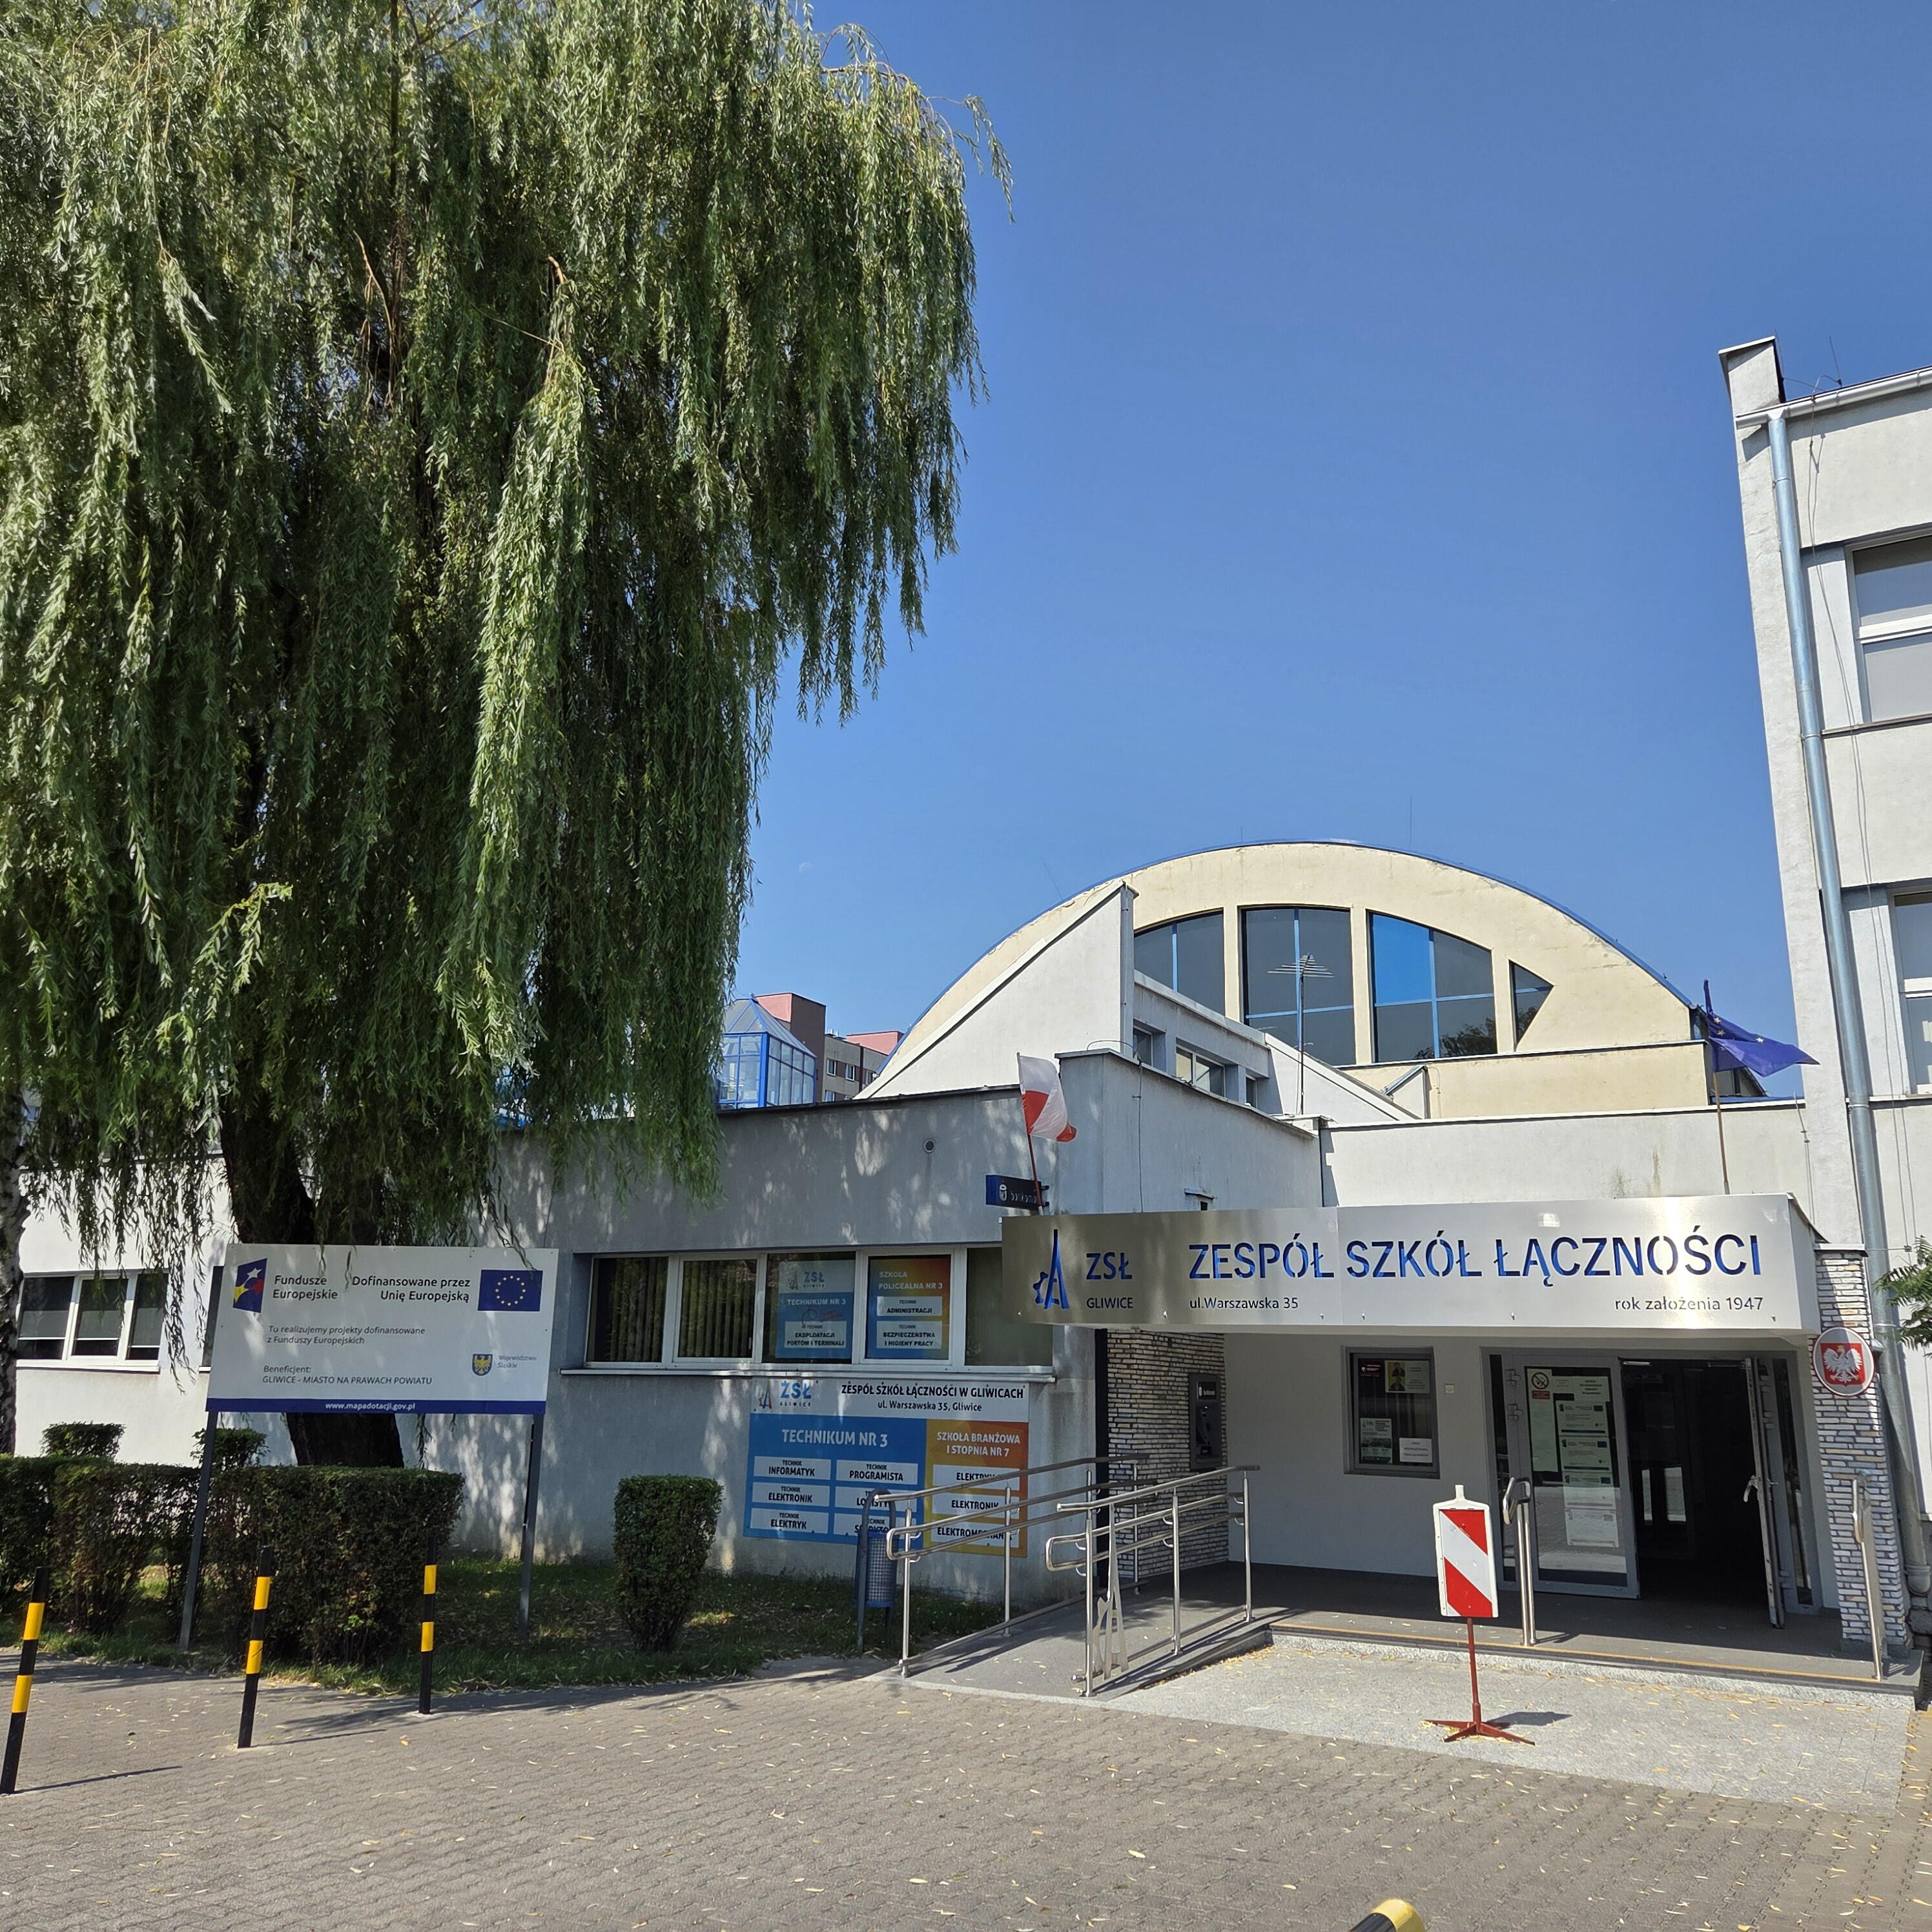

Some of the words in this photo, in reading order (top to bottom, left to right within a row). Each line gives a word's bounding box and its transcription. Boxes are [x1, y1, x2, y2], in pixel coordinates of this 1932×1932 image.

[1189, 1233, 1334, 1279] ZESPÓŁ
[1346, 1230, 1483, 1278] SZKÓŁ
[1494, 1225, 1762, 1286] ŁĄCZNOŚCI
[1086, 1252, 1132, 1280] ZSŁ
[274, 1275, 327, 1286] Fundusze
[352, 1276, 437, 1287] Dofinansowane
[440, 1279, 471, 1289] przez
[272, 1289, 338, 1301] Europejskie
[380, 1290, 406, 1302] Unię
[409, 1291, 469, 1303] Europejską
[1086, 1297, 1133, 1310] GLIWICE
[1284, 1297, 1299, 1309] 35
[1615, 1298, 1641, 1311] rok
[1645, 1296, 1721, 1311] założenia
[1726, 1297, 1763, 1311] 1947
[269, 1325, 279, 1333] Tu
[281, 1325, 327, 1335] realizujemy
[329, 1326, 362, 1335] projekty
[364, 1326, 426, 1335] dofinansowane
[273, 1336, 312, 1345] Funduszy
[313, 1337, 365, 1345] Europejskich
[263, 1365, 312, 1374] Beneficjent:
[303, 1376, 335, 1384] MIASTO
[841, 1383, 874, 1395] ZESPÓŁ
[876, 1384, 905, 1396] SZKÓŁ
[906, 1384, 958, 1399] ŁĄCZNOŚCI
[959, 1387, 969, 1397] W
[970, 1387, 1023, 1399] GLIWICACH
[325, 1403, 416, 1411] www.mapadotacji.gov.pl
[878, 1400, 887, 1408] ul.
[889, 1401, 936, 1410] Warszawska
[938, 1403, 951, 1412] 35,
[952, 1402, 982, 1412] Gliwice
[781, 1428, 856, 1445] TECHNIKUM
[859, 1432, 877, 1446] NR
[879, 1434, 889, 1448] 3
[936, 1431, 969, 1442] SZKOŁA
[971, 1432, 1020, 1444] BRANŻOWA
[947, 1445, 950, 1454] I
[951, 1445, 988, 1456] STOPNIA
[990, 1446, 1002, 1456] NR
[1004, 1448, 1010, 1457] 7
[768, 1466, 815, 1477] INFORMATYK
[849, 1470, 903, 1481] PROGRAMISTA
[768, 1492, 813, 1503] ELEKTRONIK
[770, 1519, 807, 1530] ELEKTRYK
